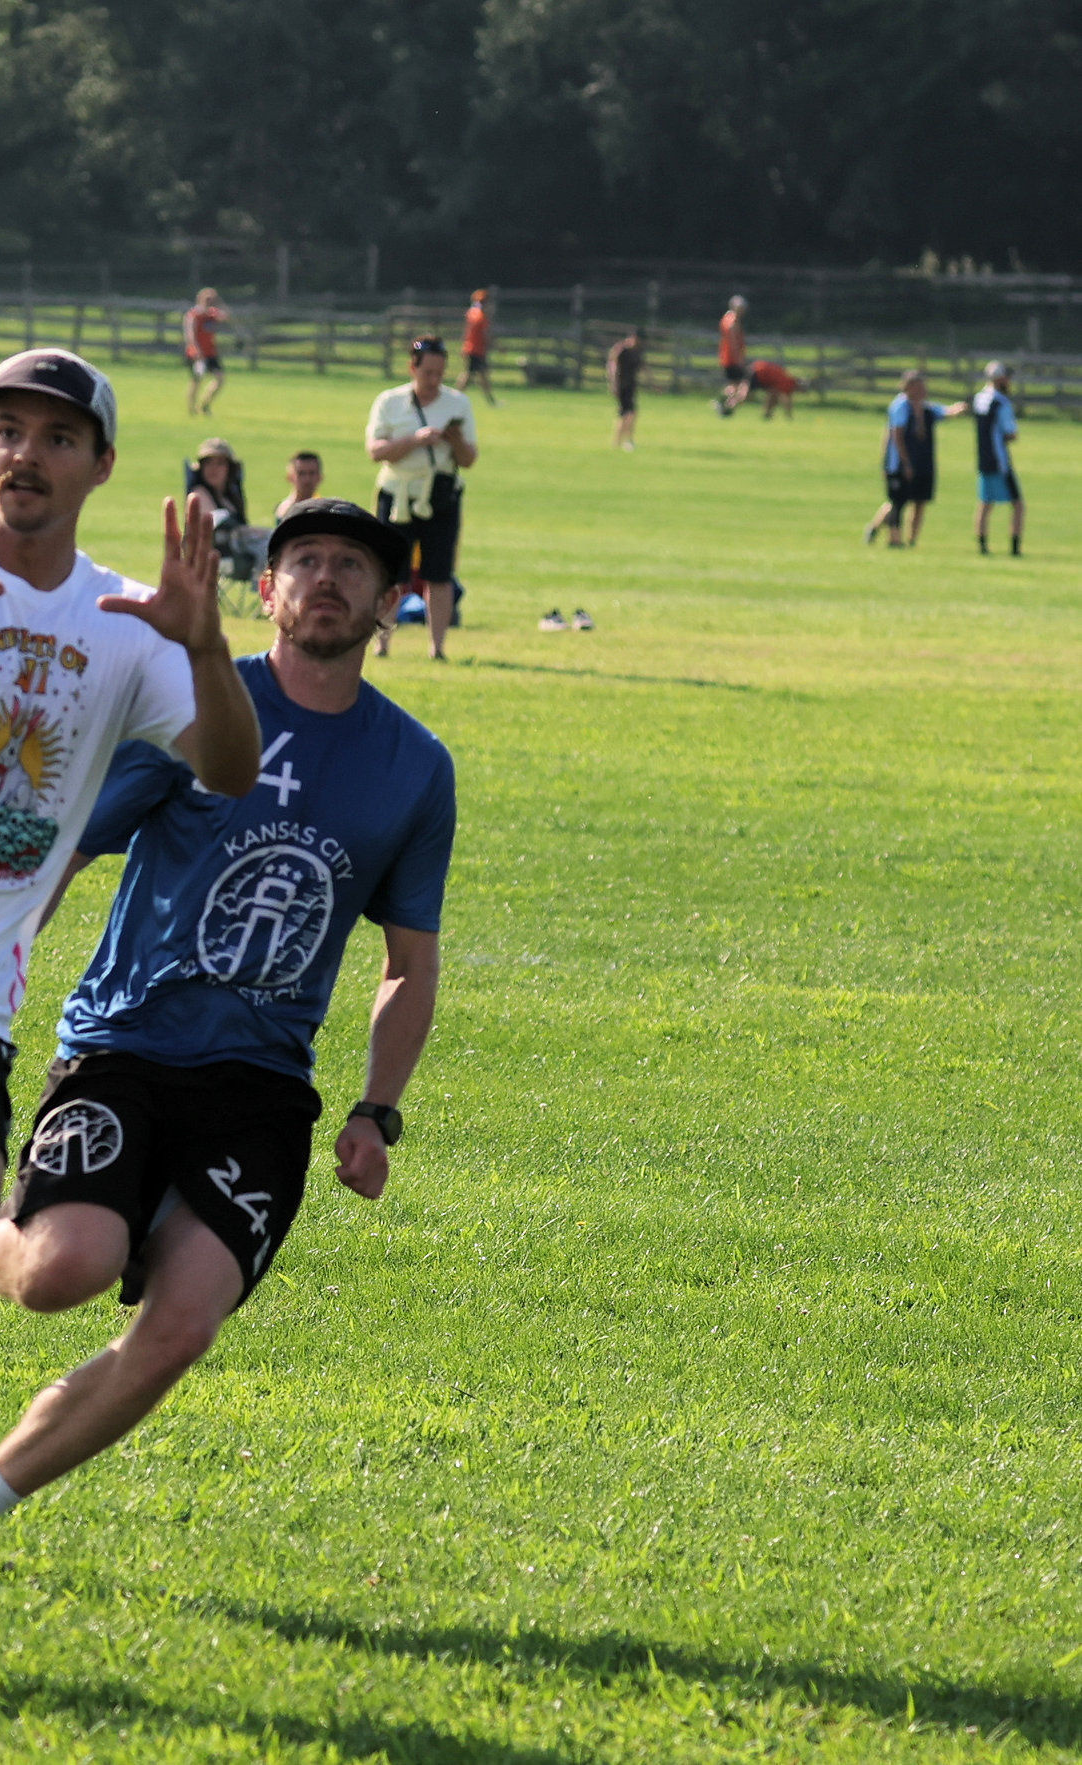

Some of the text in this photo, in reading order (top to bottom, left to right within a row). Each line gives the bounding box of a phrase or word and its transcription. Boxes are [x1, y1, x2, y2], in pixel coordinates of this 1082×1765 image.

[223, 821, 353, 882] KANSAS CITY
[207, 1156, 272, 1235] 24
